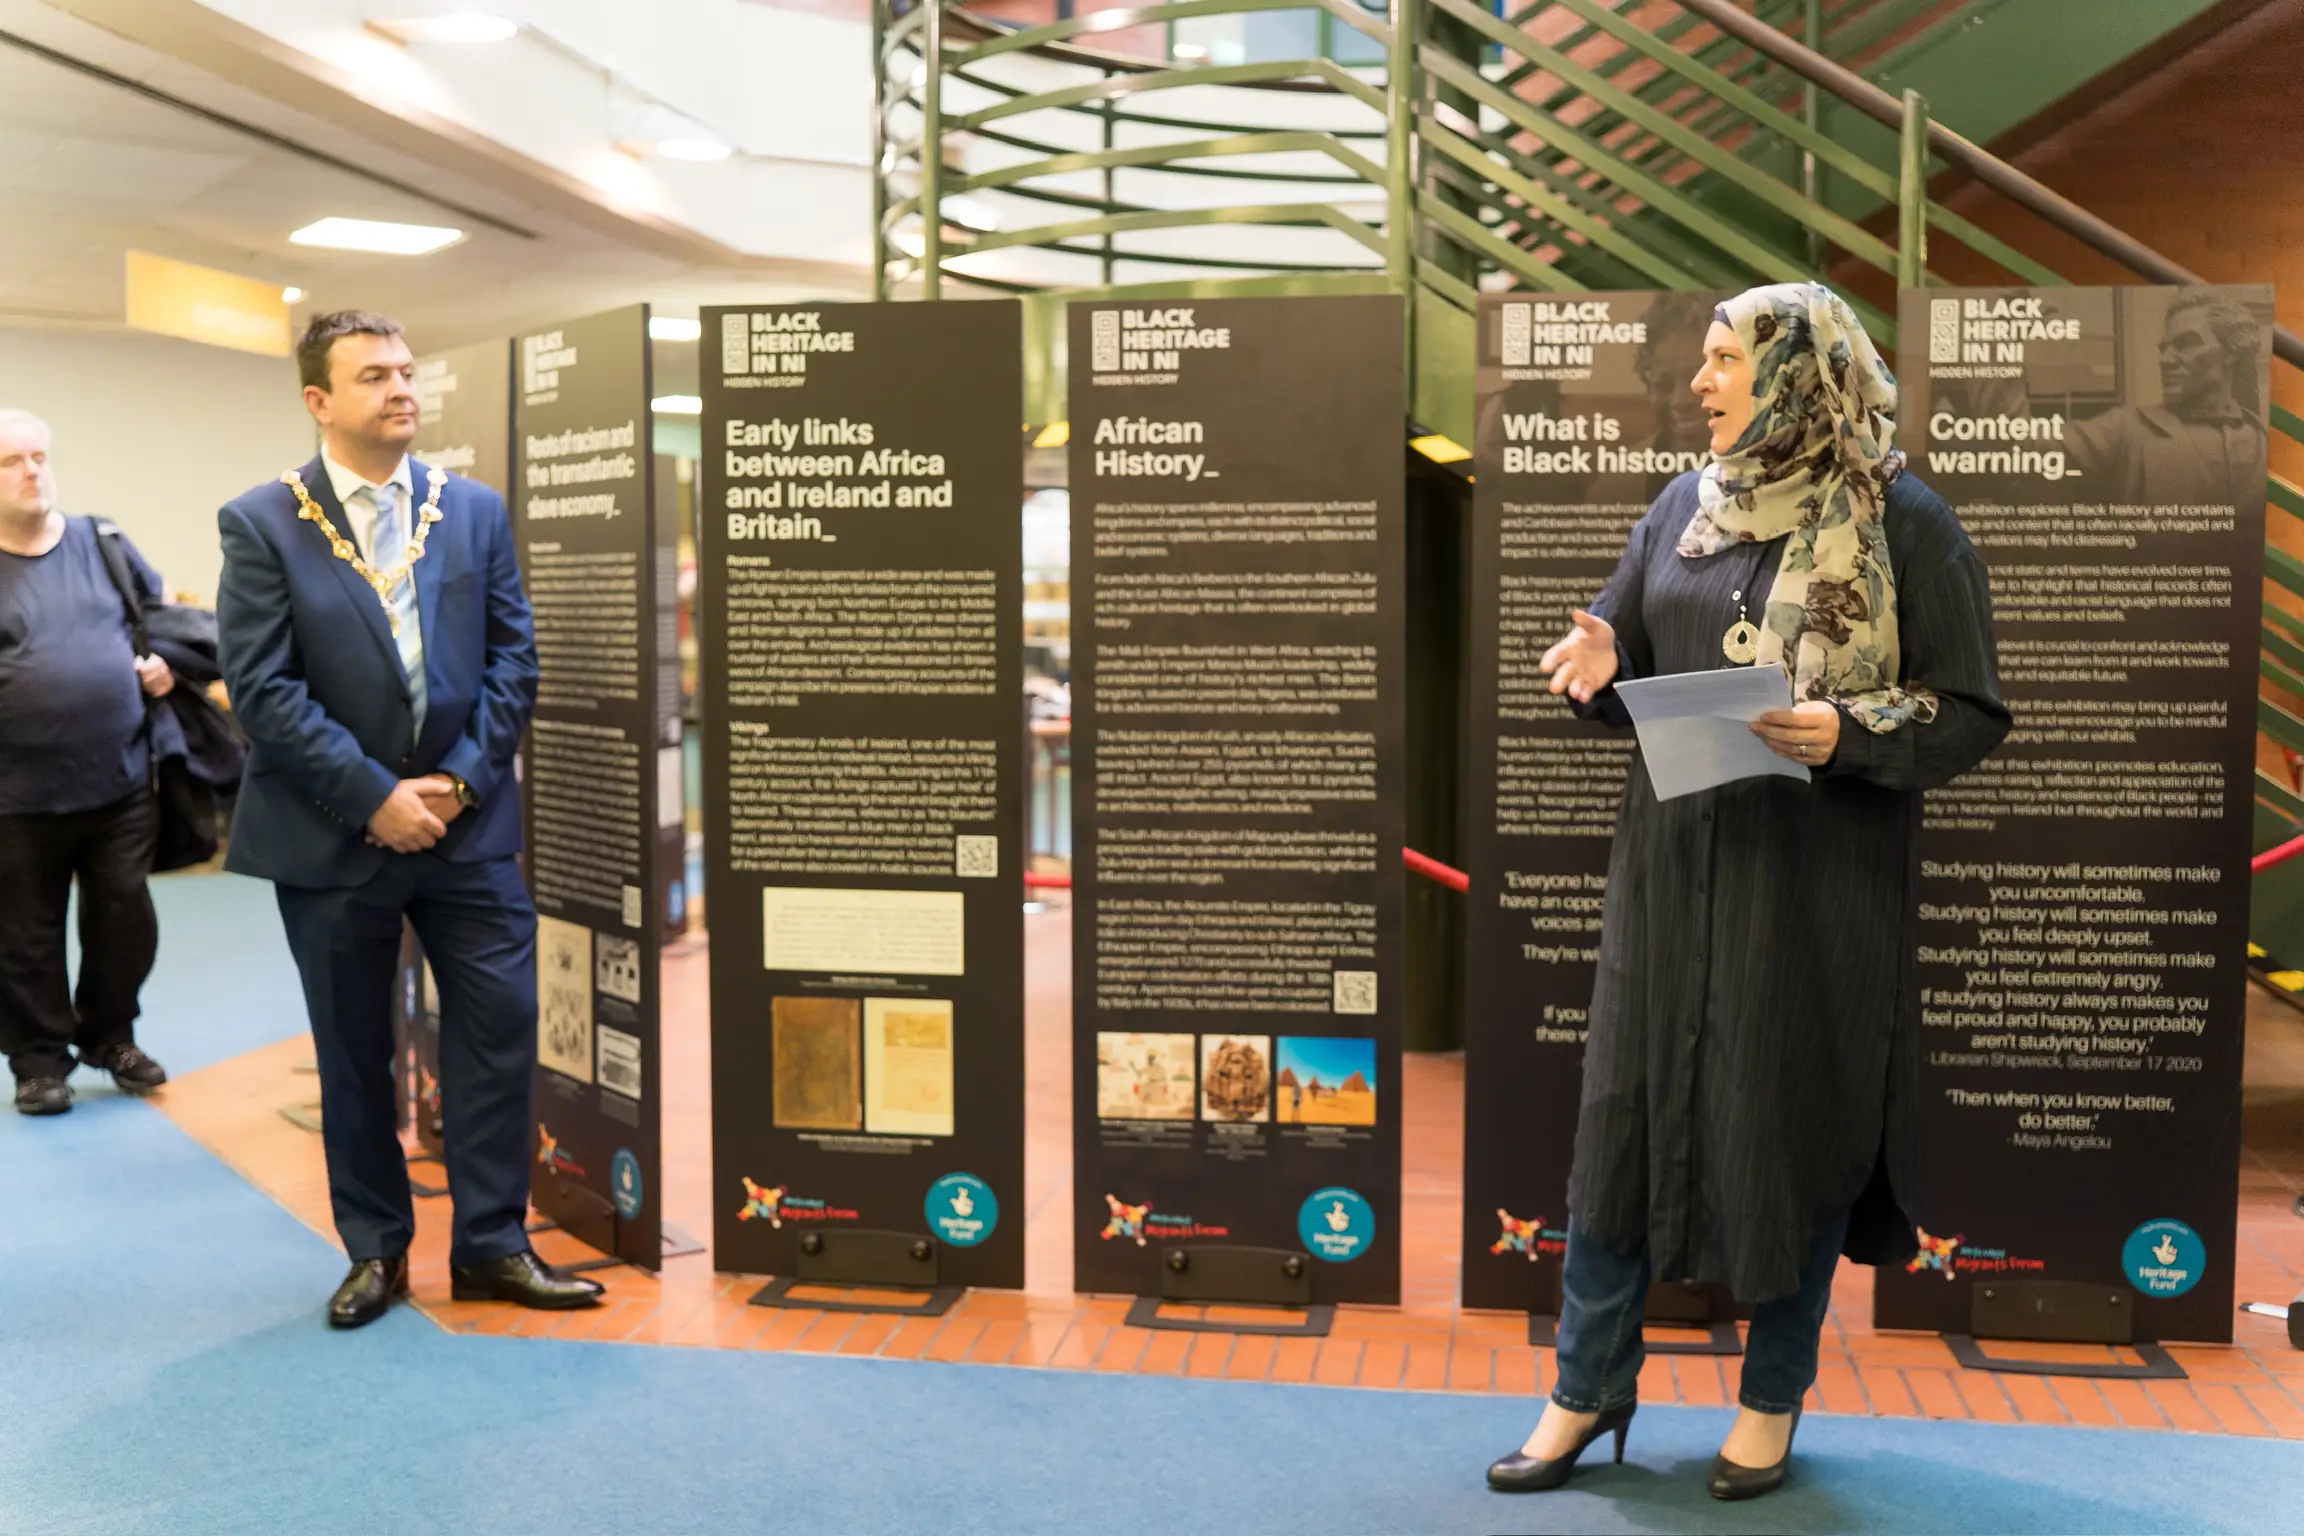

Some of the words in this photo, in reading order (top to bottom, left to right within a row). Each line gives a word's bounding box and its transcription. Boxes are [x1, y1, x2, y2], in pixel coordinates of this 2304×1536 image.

[1123, 309, 1195, 328] BLACK
[1534, 302, 1610, 322] BLACK
[1964, 298, 2042, 319] BLACK
[752, 313, 820, 332] BLACK
[1534, 323, 1647, 343] HERITAGE
[1964, 319, 2081, 341] HERITAGE
[752, 332, 854, 352] HERITAGE
[1123, 329, 1230, 350] HERITAGE
[1123, 352, 1148, 370] IN
[1153, 352, 1179, 370] NI
[1534, 346, 1561, 365] IN
[1566, 346, 1593, 365] NI
[1963, 343, 1992, 363] IN
[1997, 343, 2024, 363] NI
[752, 355, 776, 373] IN
[781, 355, 806, 373] NI
[1502, 369, 1543, 380] HIDDEN
[1545, 369, 1592, 380] HISTORY
[1929, 366, 1972, 379] HIDDEN
[1974, 366, 2024, 379] HISTORY
[726, 420, 798, 452] Early
[803, 417, 874, 445] links
[1094, 417, 1203, 445] African
[1502, 413, 1588, 441] What
[1593, 412, 1621, 440] is
[1929, 412, 2064, 441] Content
[726, 450, 853, 477] between
[858, 449, 945, 476] Africa
[1095, 451, 1220, 481] History_
[1503, 446, 1591, 473] Black
[1928, 446, 2082, 481] warning_
[726, 481, 781, 508] and
[788, 480, 890, 508] Ireland
[895, 480, 953, 508] and
[1955, 503, 2015, 516] exhibition
[2017, 503, 2070, 517] explores
[2071, 503, 2107, 517] Black
[2109, 503, 2150, 518] history
[2153, 504, 2179, 517] and
[2180, 504, 2236, 517] contains
[727, 513, 837, 542] Britain_
[1982, 518, 2005, 531] and
[2006, 519, 2050, 532] content
[2051, 519, 2074, 532] that
[2075, 519, 2086, 531] is
[2087, 518, 2118, 531] often
[2118, 519, 2158, 533] racially
[2160, 518, 2209, 533] charged
[2210, 518, 2235, 531] and
[1983, 534, 2023, 547] visitors
[2024, 535, 2048, 549] may
[2051, 533, 2073, 547] find
[1996, 861, 2051, 884] history
[2053, 862, 2080, 880] will
[2082, 865, 2172, 882] sometimes
[2175, 864, 2221, 883] make
[1500, 892, 1539, 909] have
[1540, 896, 1562, 909] an
[1988, 886, 2021, 903] you
[1531, 915, 1582, 932] voices
[1918, 903, 1991, 924] Studying
[1993, 904, 2048, 925] history
[2050, 906, 2077, 922] will
[2079, 907, 2169, 924] sometimes
[2171, 908, 2218, 925] make
[1978, 928, 2010, 946] you
[2013, 925, 2043, 943] feel
[2044, 926, 2102, 948] deeply
[1916, 945, 1989, 968] Studying
[1991, 947, 2047, 968] history
[2049, 949, 2075, 965] will
[2077, 950, 2167, 968] sometimes
[2170, 951, 2216, 968] make
[1965, 971, 1997, 988] you
[1999, 968, 2029, 986] feel
[2031, 970, 2112, 992] extremely
[1921, 987, 1932, 1004] If
[1933, 988, 2003, 1010] studying
[2005, 990, 2060, 1011] history
[2062, 992, 2118, 1012] always
[2121, 993, 2174, 1010] makes
[2177, 997, 2209, 1014] you
[1922, 1008, 1952, 1026] feel
[1954, 1010, 2003, 1030] proud
[2006, 1010, 2038, 1028] and
[2098, 1017, 2129, 1034] you
[2132, 1014, 2206, 1036] probably
[2018, 1034, 2089, 1055] studying
[1994, 1090, 2039, 1107] when
[2042, 1097, 2073, 1111] you
[2076, 1092, 2121, 1110] know
[2125, 1094, 2175, 1113] better,
[2018, 1112, 2042, 1130] do
[2139, 1266, 2188, 1282] Heritage
[2150, 1278, 2177, 1290] Fund
